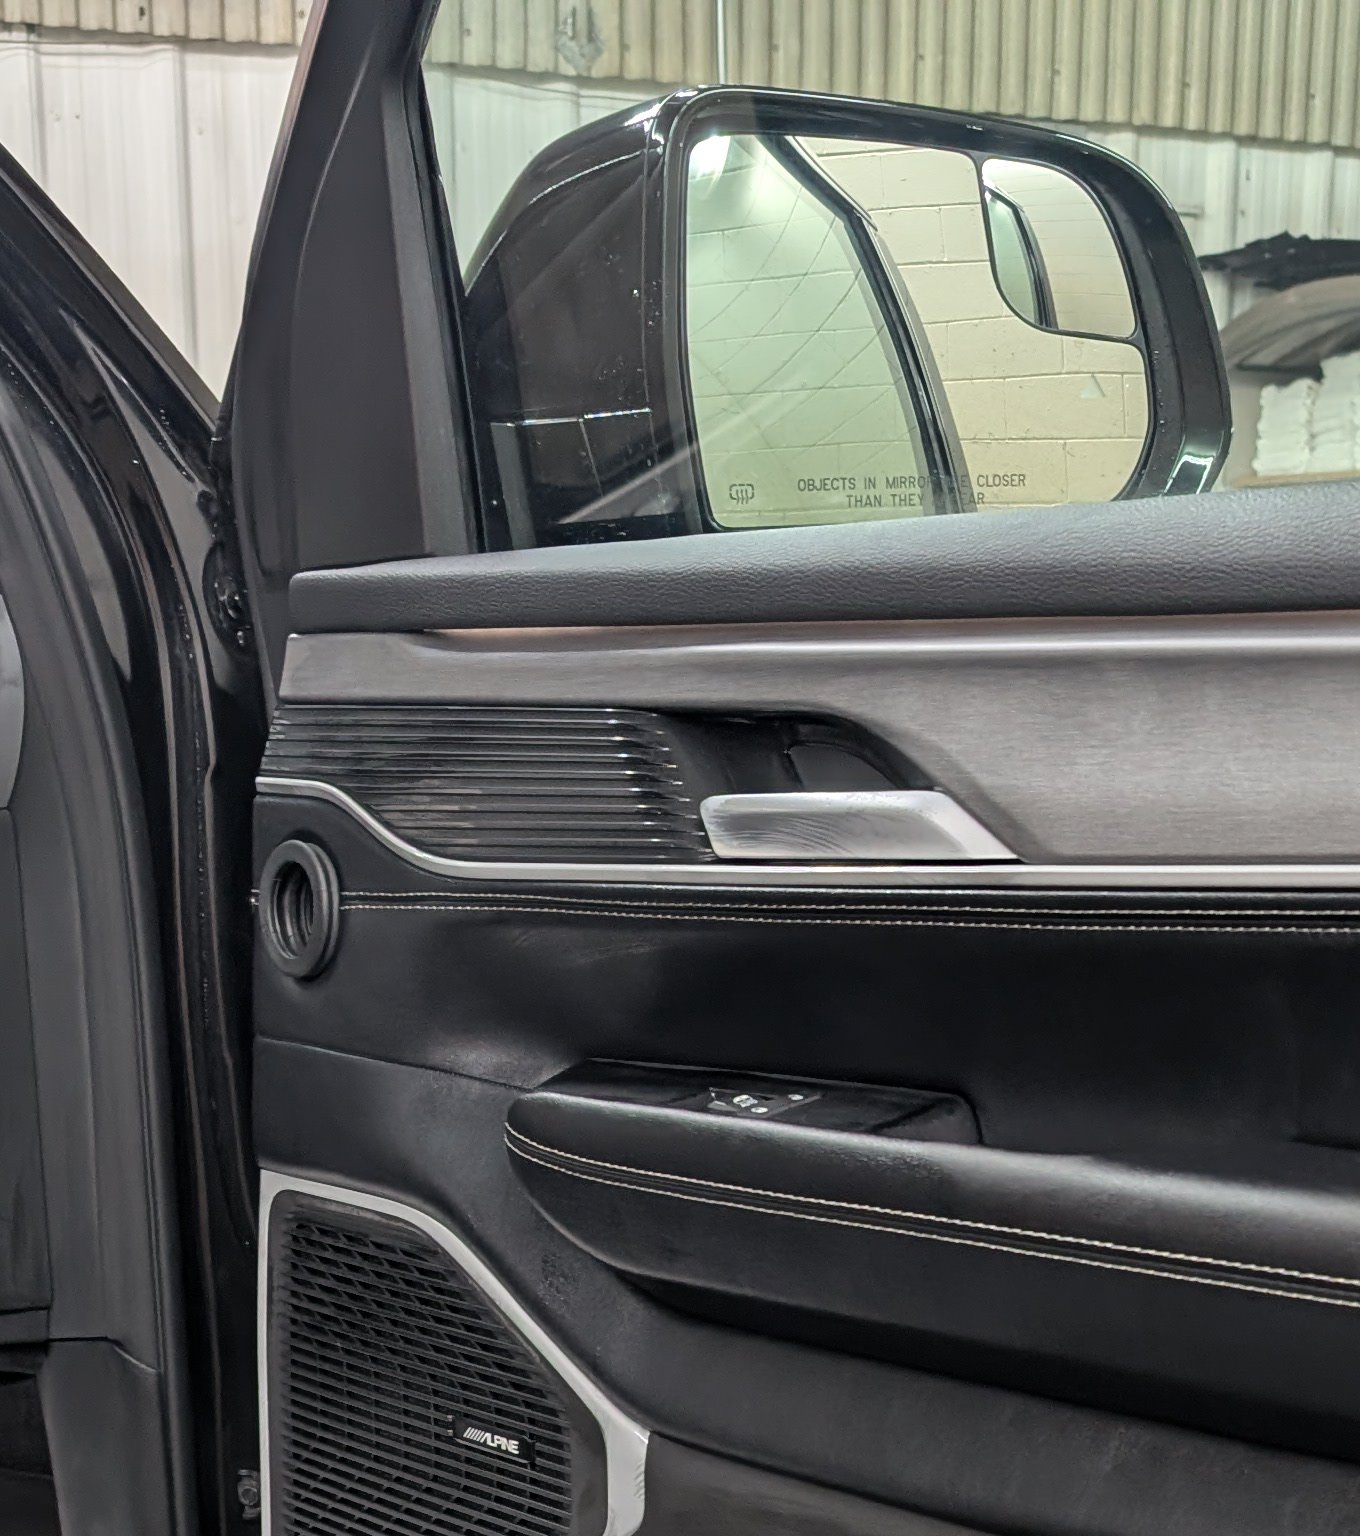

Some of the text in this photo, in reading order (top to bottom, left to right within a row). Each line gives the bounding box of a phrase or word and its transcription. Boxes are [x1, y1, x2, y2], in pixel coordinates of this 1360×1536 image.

[797, 477, 857, 492] OBJECTS
[864, 476, 877, 490] IN
[976, 473, 1027, 488] CLOSER
[846, 494, 882, 508] THAN
[890, 493, 925, 507] THEY
